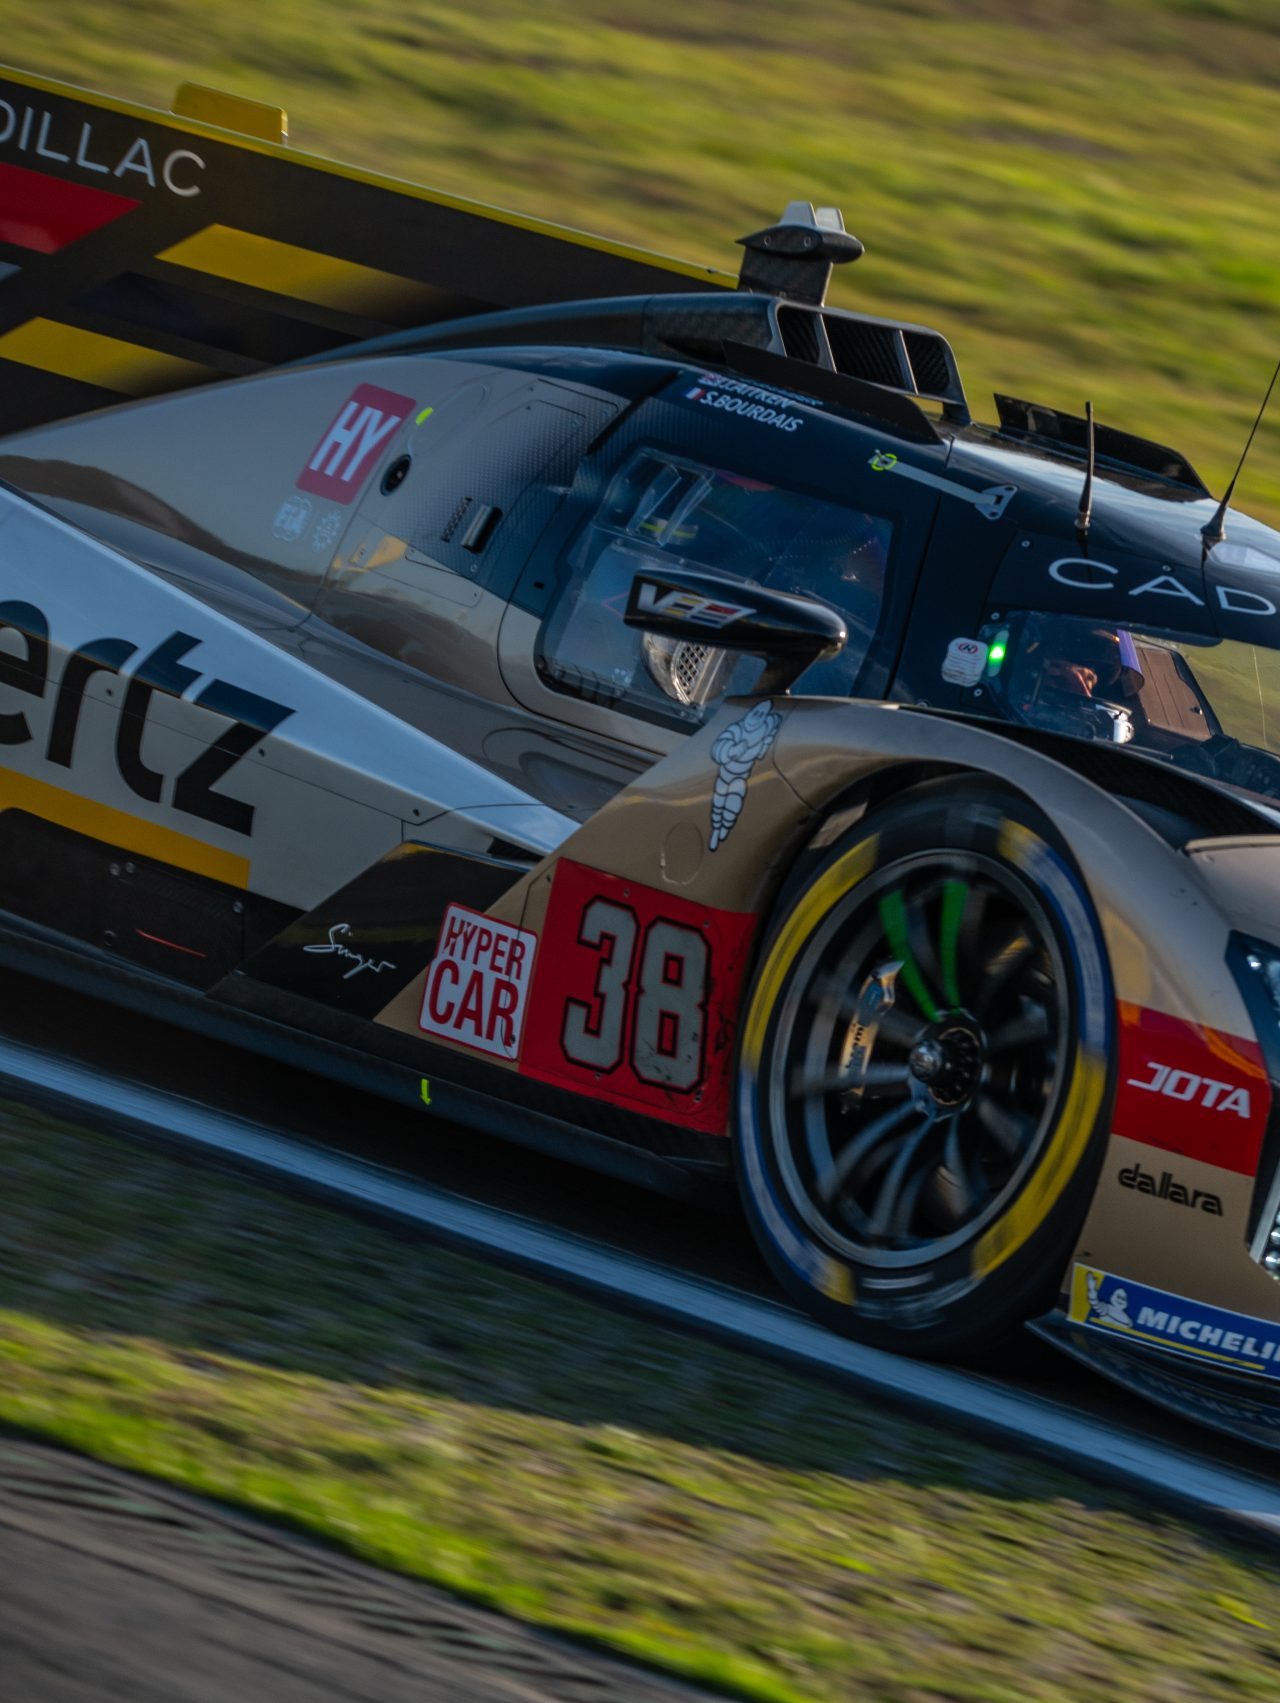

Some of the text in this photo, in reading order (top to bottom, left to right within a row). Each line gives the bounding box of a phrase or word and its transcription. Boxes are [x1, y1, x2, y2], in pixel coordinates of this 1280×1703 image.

[308, 401, 401, 482] HY
[700, 391, 804, 432] S.BOURDAIS
[443, 915, 527, 980] HYPER
[428, 959, 521, 1048] CAR
[559, 896, 712, 1095] 38
[1127, 1062, 1251, 1119] JOTA
[1117, 1164, 1224, 1216] dallara
